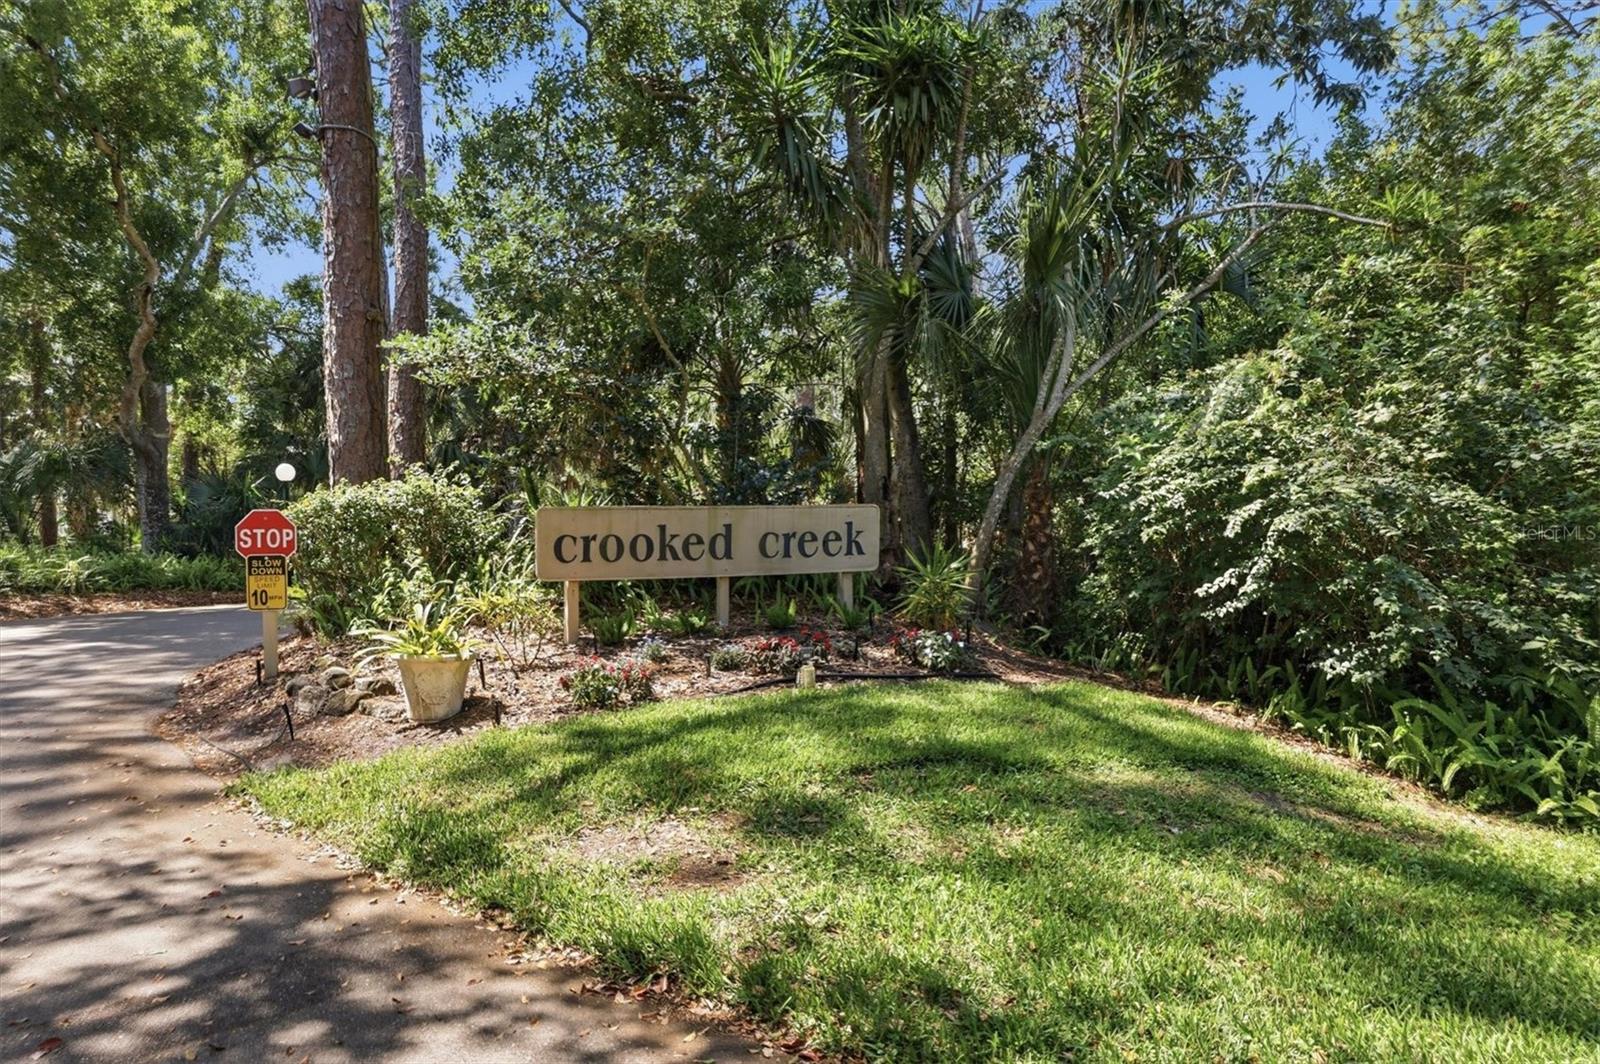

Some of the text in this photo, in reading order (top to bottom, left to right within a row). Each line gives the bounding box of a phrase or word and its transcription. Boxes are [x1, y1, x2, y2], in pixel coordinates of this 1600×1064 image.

[240, 528, 294, 549] STOP
[553, 521, 866, 564] crooked creek
[251, 559, 282, 567] SLOW
[251, 567, 283, 575] DOWN
[251, 588, 269, 606] 10
